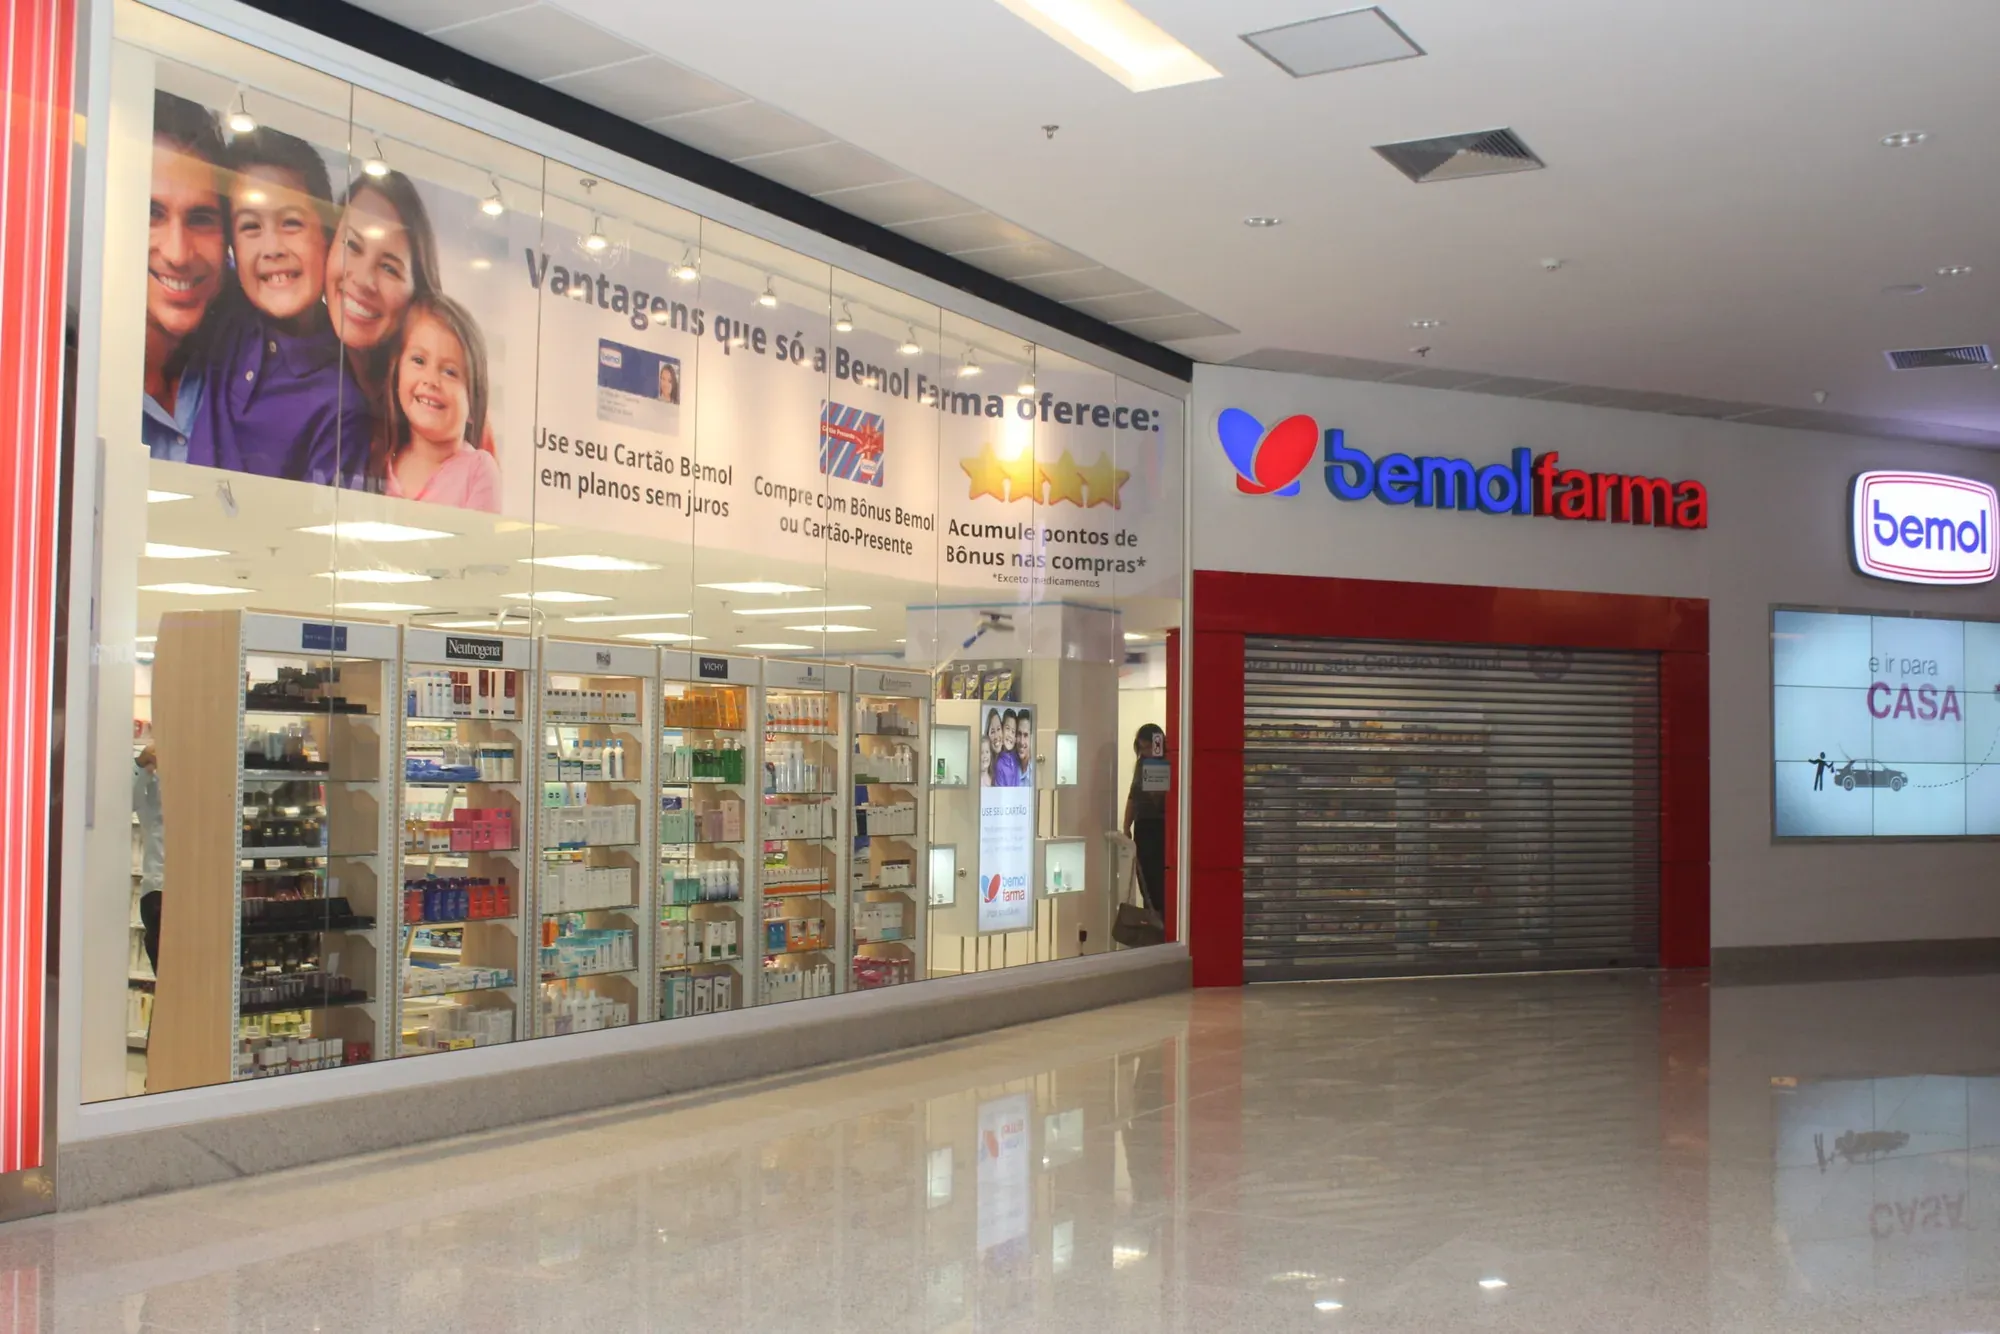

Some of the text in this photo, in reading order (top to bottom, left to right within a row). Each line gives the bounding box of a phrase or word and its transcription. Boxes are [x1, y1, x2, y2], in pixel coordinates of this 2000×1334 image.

[525, 248, 1160, 432] Vantagens que só a Bemol Farma oferece:
[534, 427, 732, 486] Use seu Cartão Bemol
[541, 467, 729, 517] em planos sem juros
[755, 476, 935, 531] Compre com Bônus Bemol
[780, 516, 913, 556] ou Cartão-Presente
[949, 519, 1138, 547] Acumule pontos de
[1873, 499, 1987, 554] bemol
[946, 545, 1005, 566] Bônus
[1012, 553, 1045, 568] nas
[1031, 576, 1100, 588] medicamentos
[448, 639, 500, 659] Neutrogena
[703, 662, 724, 671] VICHY
[1868, 652, 1938, 678] e ir para
[1867, 681, 1962, 721] CASA
[982, 807, 993, 817] USE
[1005, 804, 1027, 816] CARTÃO
[1003, 889, 1025, 902] farma
